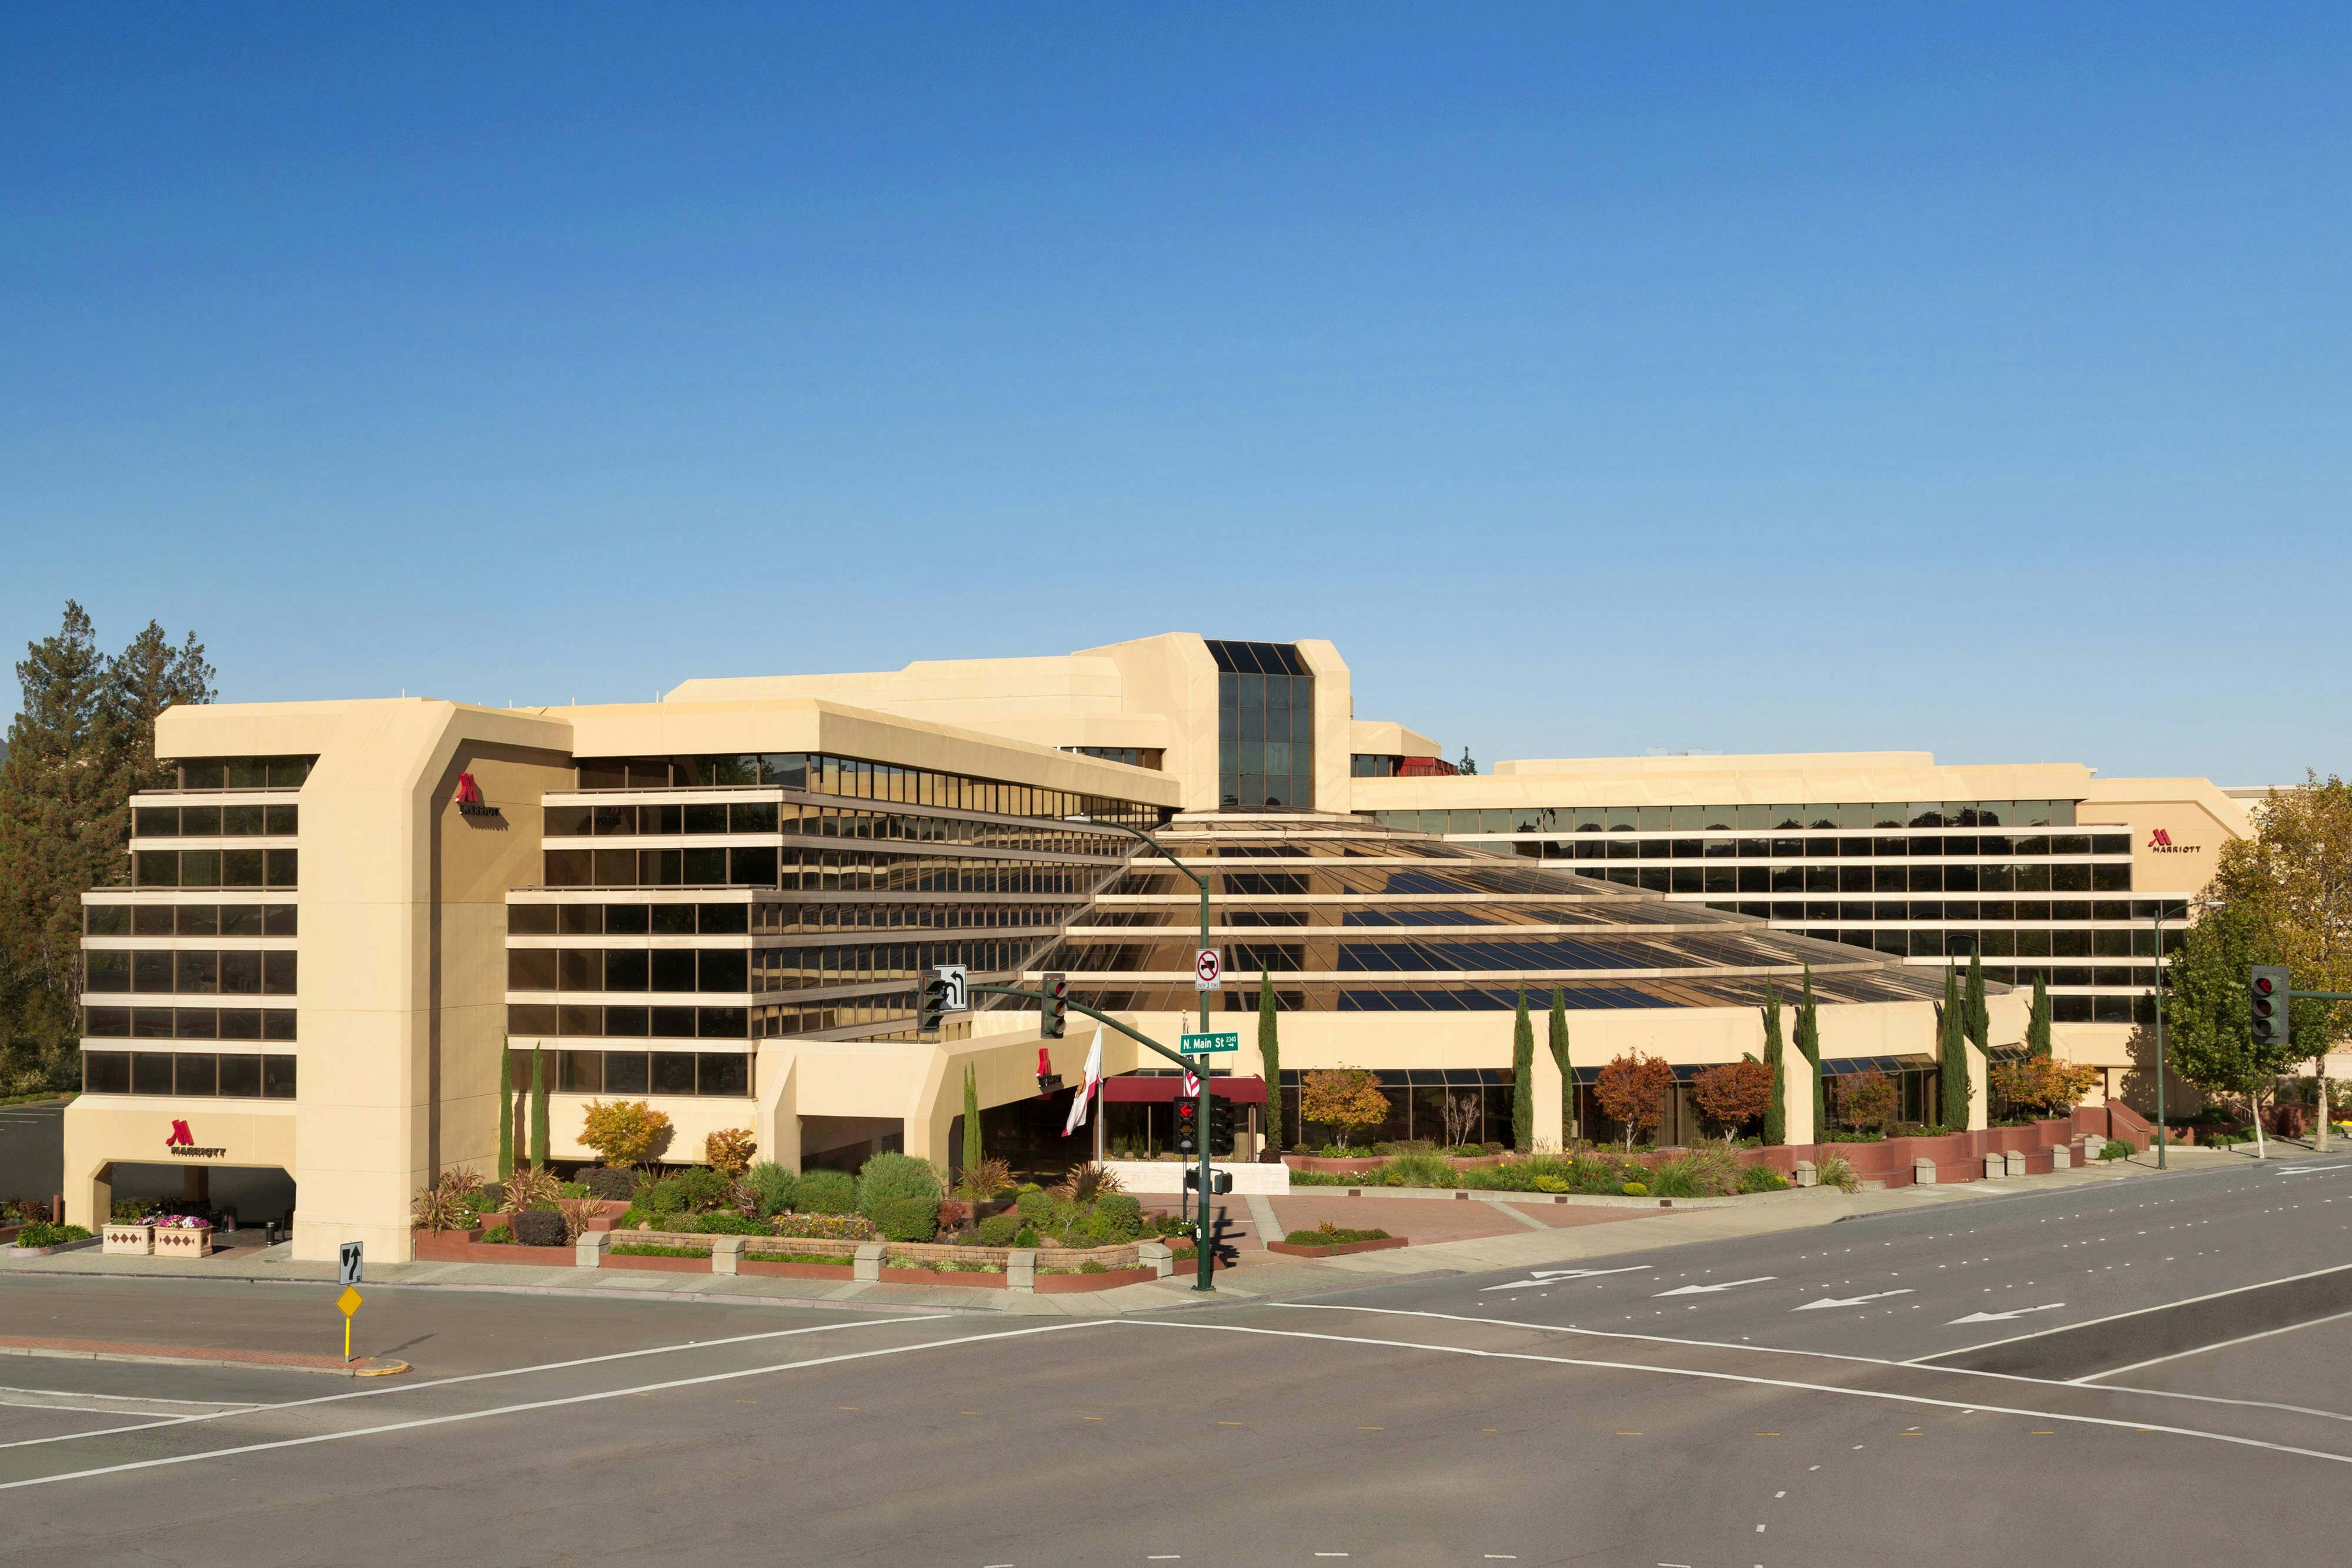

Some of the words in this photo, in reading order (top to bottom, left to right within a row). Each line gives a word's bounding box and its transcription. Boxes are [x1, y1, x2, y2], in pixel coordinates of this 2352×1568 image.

[1183, 1039, 1191, 1049] N.
[1194, 1038, 1211, 1049] Main
[1215, 1037, 1224, 1048] St
[171, 1147, 226, 1157] MARRIOTT
